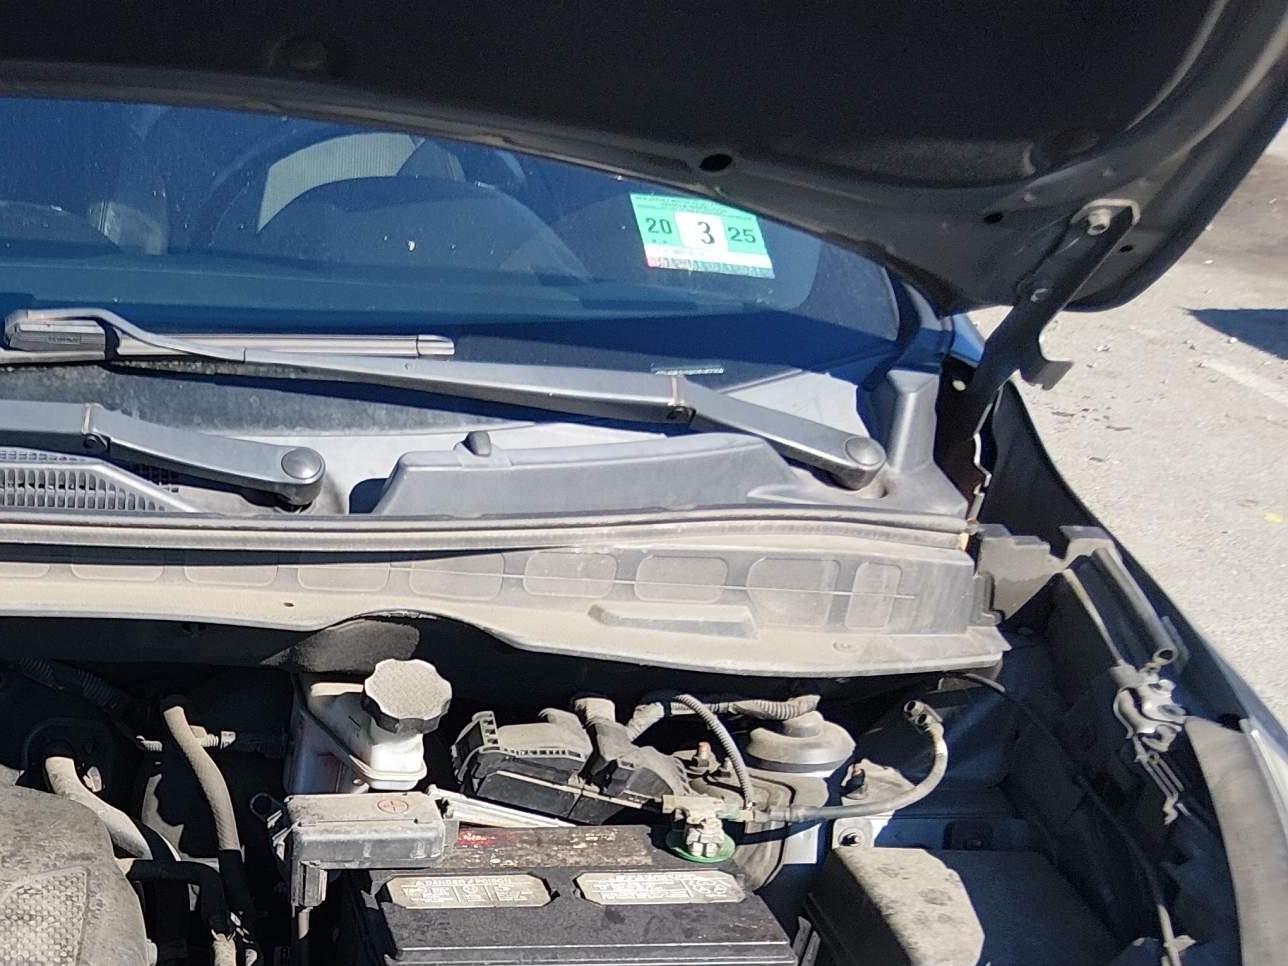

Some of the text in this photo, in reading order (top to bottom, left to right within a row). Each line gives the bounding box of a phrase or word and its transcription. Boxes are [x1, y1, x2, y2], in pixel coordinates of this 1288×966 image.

[645, 217, 757, 245] 20 3 25
